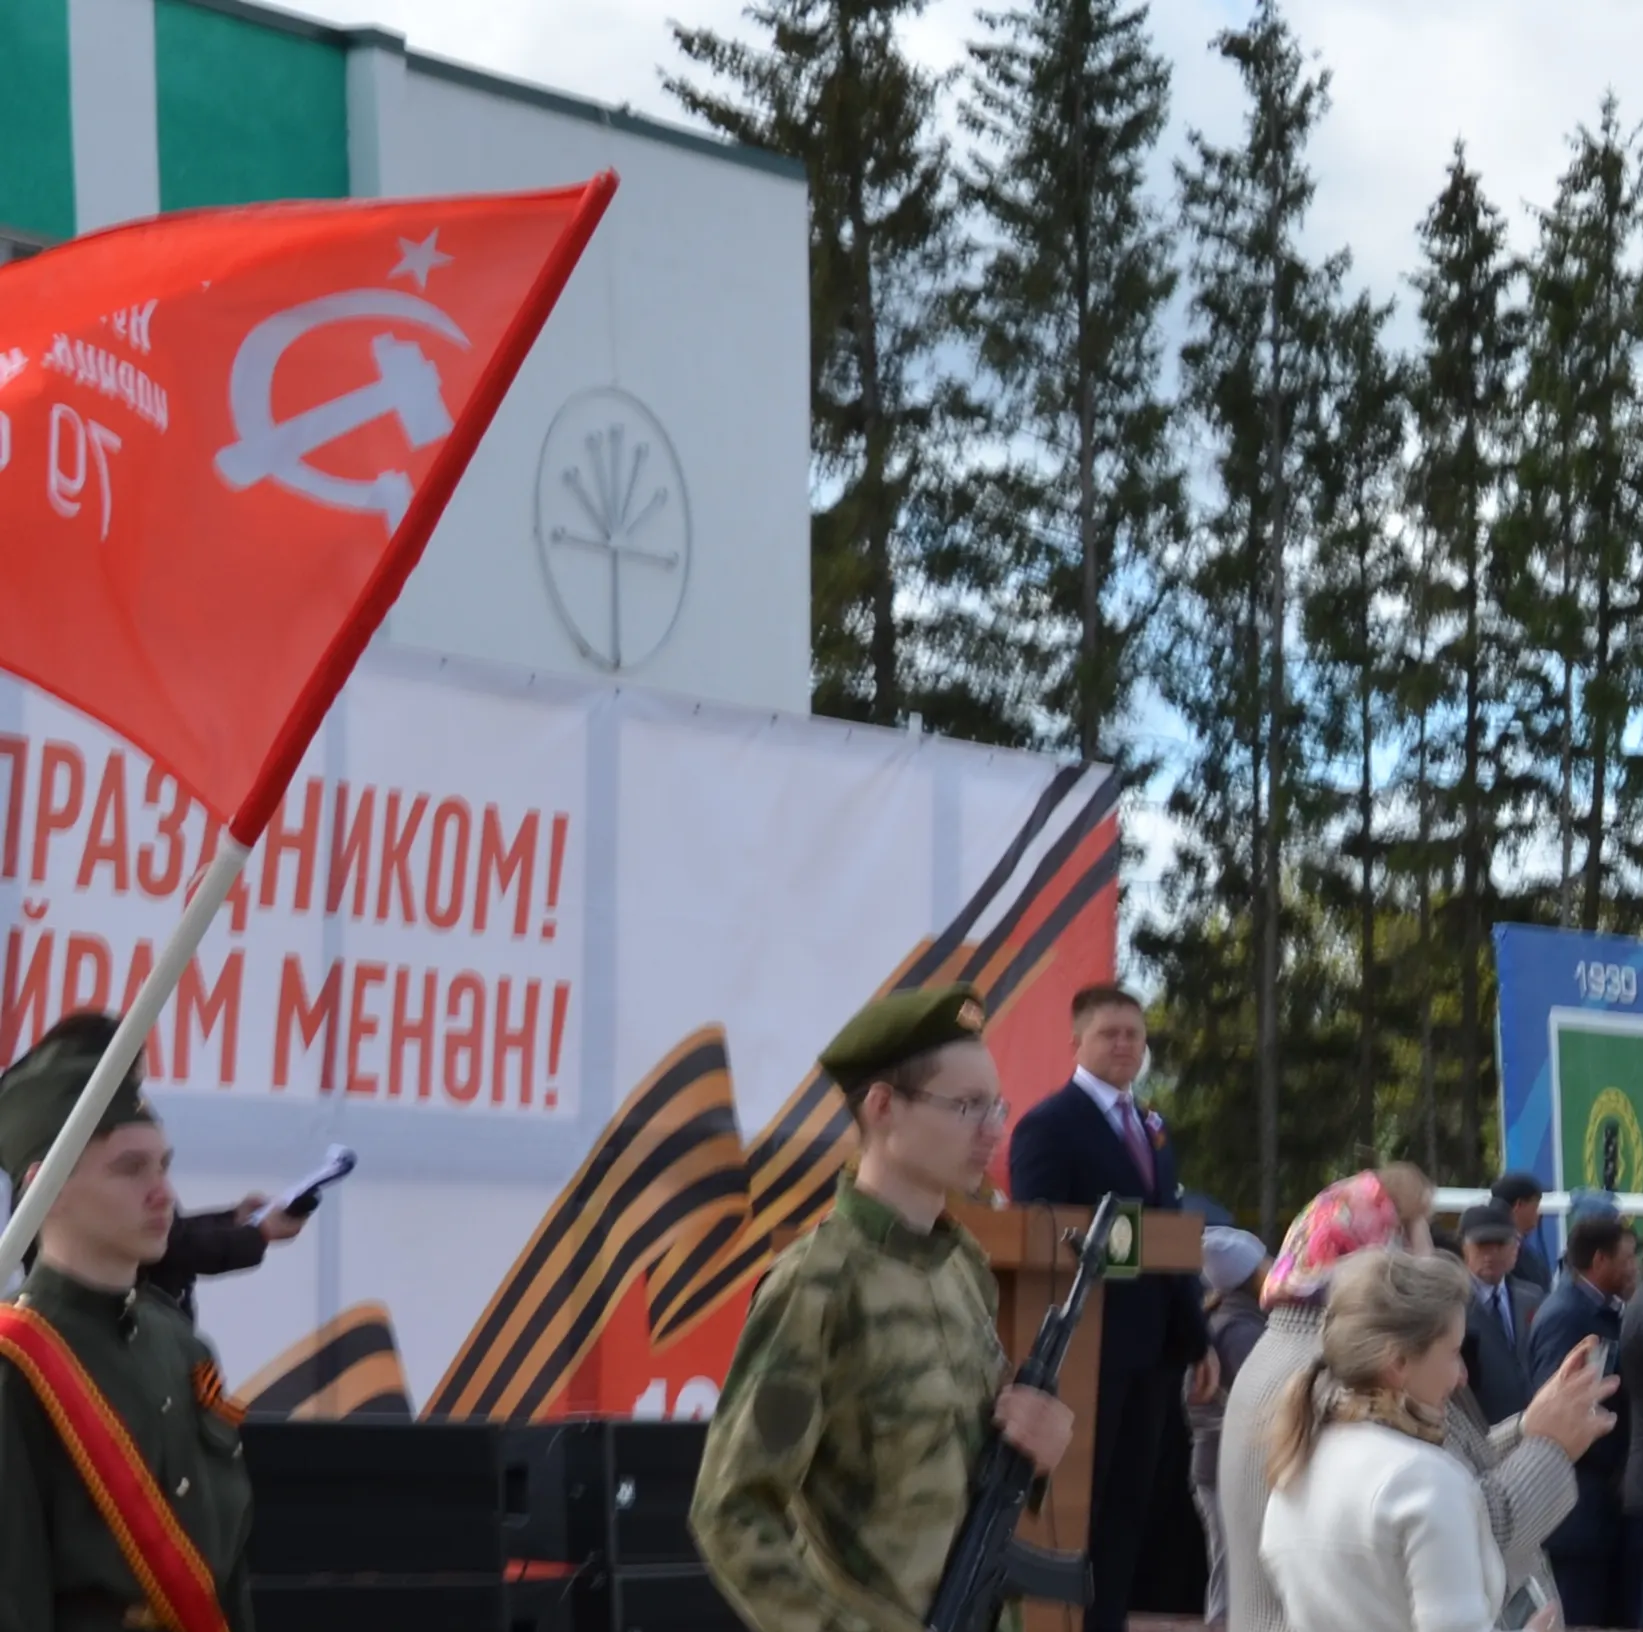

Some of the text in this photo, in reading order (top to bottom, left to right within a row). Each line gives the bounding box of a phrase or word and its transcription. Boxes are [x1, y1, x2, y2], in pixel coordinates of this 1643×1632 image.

[0, 898, 571, 1111] ЙРАМ МЕНӘН!
[1574, 959, 1639, 1005] 1930
